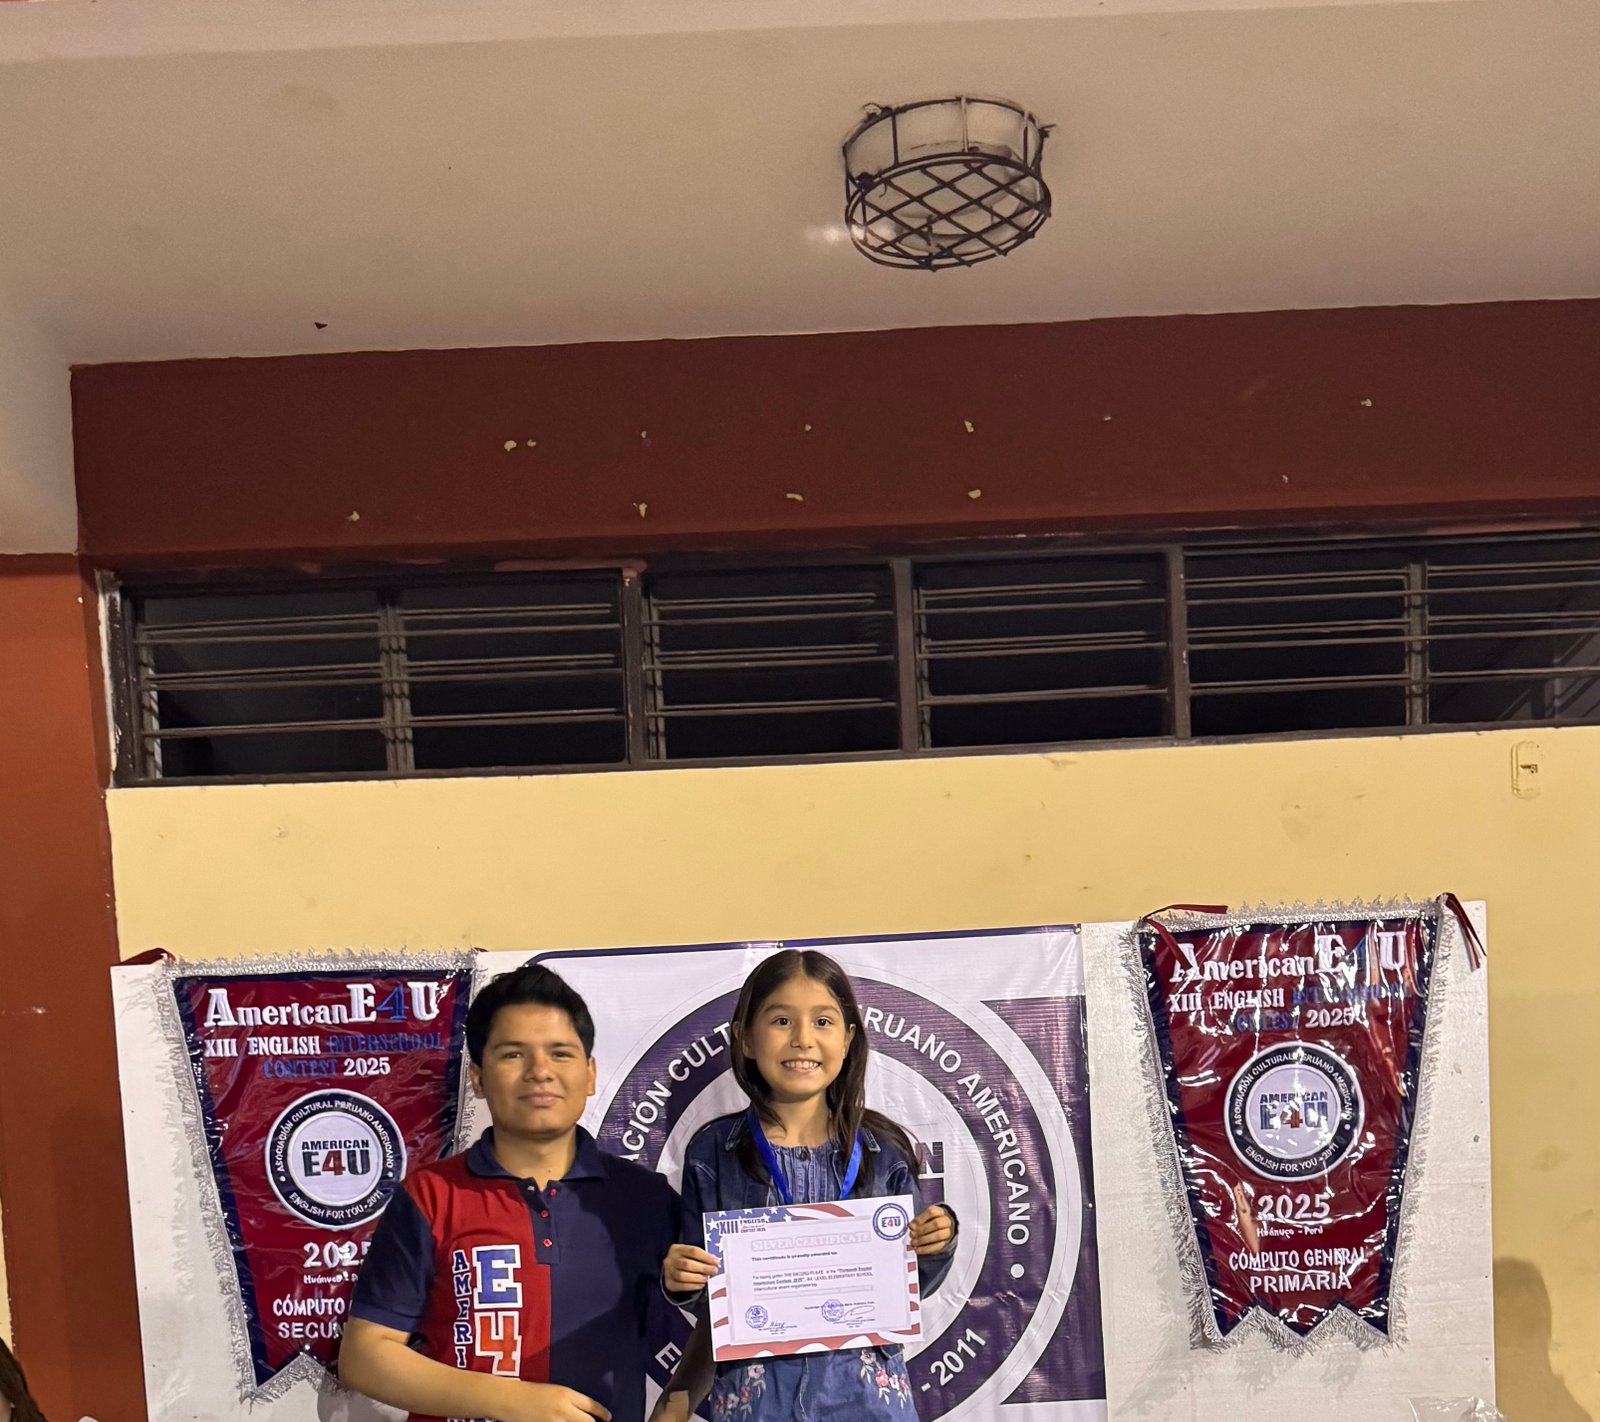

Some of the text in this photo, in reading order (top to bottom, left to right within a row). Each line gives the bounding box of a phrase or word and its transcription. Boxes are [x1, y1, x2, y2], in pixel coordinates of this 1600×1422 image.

[1168, 993, 1202, 1012] XIII
[1212, 988, 1285, 1009] ENGLISH
[1305, 1007, 1355, 1028] 2025
[204, 1038, 238, 1058] XIII
[247, 1036, 322, 1056] ENGLISH
[263, 1057, 391, 1080] CONTEST 2025
[668, 1021, 731, 1082] CULT
[859, 1004, 962, 1073] RUANO
[957, 1072, 1030, 1246] AMERICANO
[302, 1139, 369, 1151] AMERICAN
[302, 1149, 371, 1177] E4U
[1245, 1146, 1279, 1171] ENGLISH
[1279, 1163, 1299, 1173] FOR
[1299, 1159, 1318, 1170] YOU
[289, 1191, 325, 1218] ENGLISH
[325, 1209, 345, 1219] FOR
[345, 1205, 364, 1218] YOU
[1257, 1193, 1331, 1220] 2025
[719, 1220, 739, 1234] XIII
[881, 1219, 901, 1228] E4U
[751, 1238, 794, 1251] SILVER
[1229, 1246, 1369, 1271] CÓMPUTO GENERAL
[1250, 1271, 1352, 1293] PRIMARIA
[272, 1293, 345, 1317] CÓMPUTO
[930, 1327, 986, 1387] 2011
